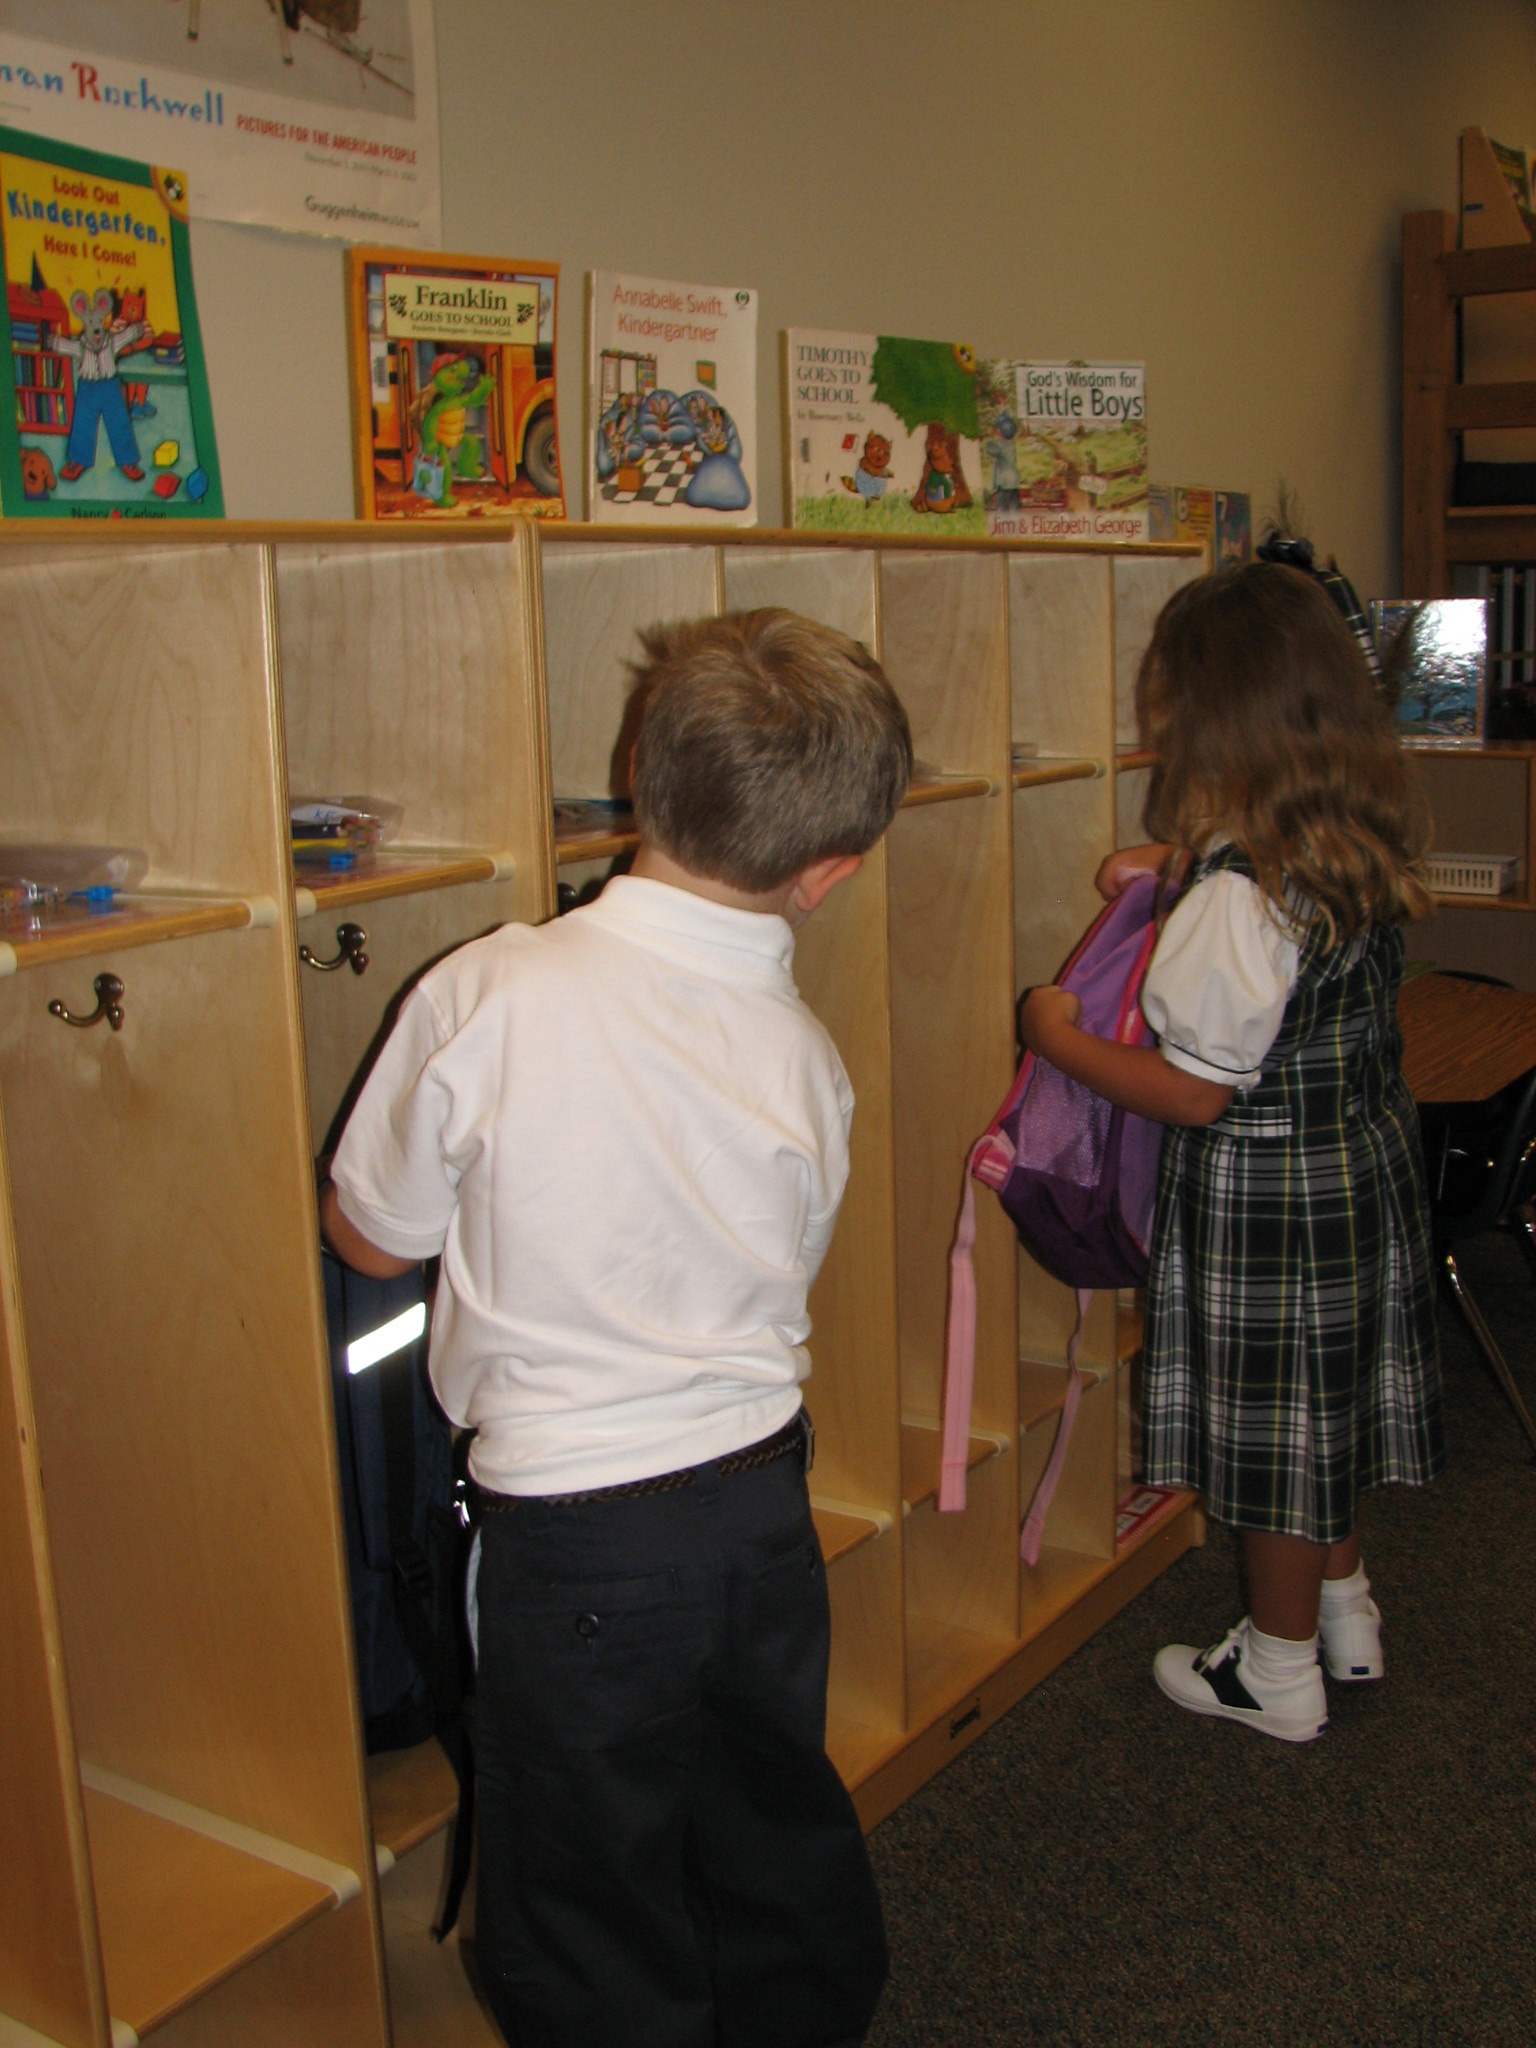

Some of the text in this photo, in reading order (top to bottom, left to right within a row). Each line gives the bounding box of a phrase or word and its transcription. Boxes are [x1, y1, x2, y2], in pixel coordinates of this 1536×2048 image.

[236, 114, 418, 165] PICTURES FOR THE AMERICAN PEOPLE
[53, 174, 120, 206] Look Out
[43, 234, 137, 268] Here I Come!
[416, 284, 508, 312] Franklin
[613, 285, 729, 319] Annabelle Swift,
[410, 310, 514, 328] GOES TO SCHOOL
[618, 313, 720, 343] Kindergartner
[798, 345, 870, 368] TIMOTHY
[797, 365, 861, 384] GOES TO
[1026, 371, 1138, 388] God's Wisdom for
[798, 385, 860, 405] SCHOOL
[1026, 387, 1143, 423] Little Boys
[991, 516, 1143, 537] Jim & Elizabeth George
